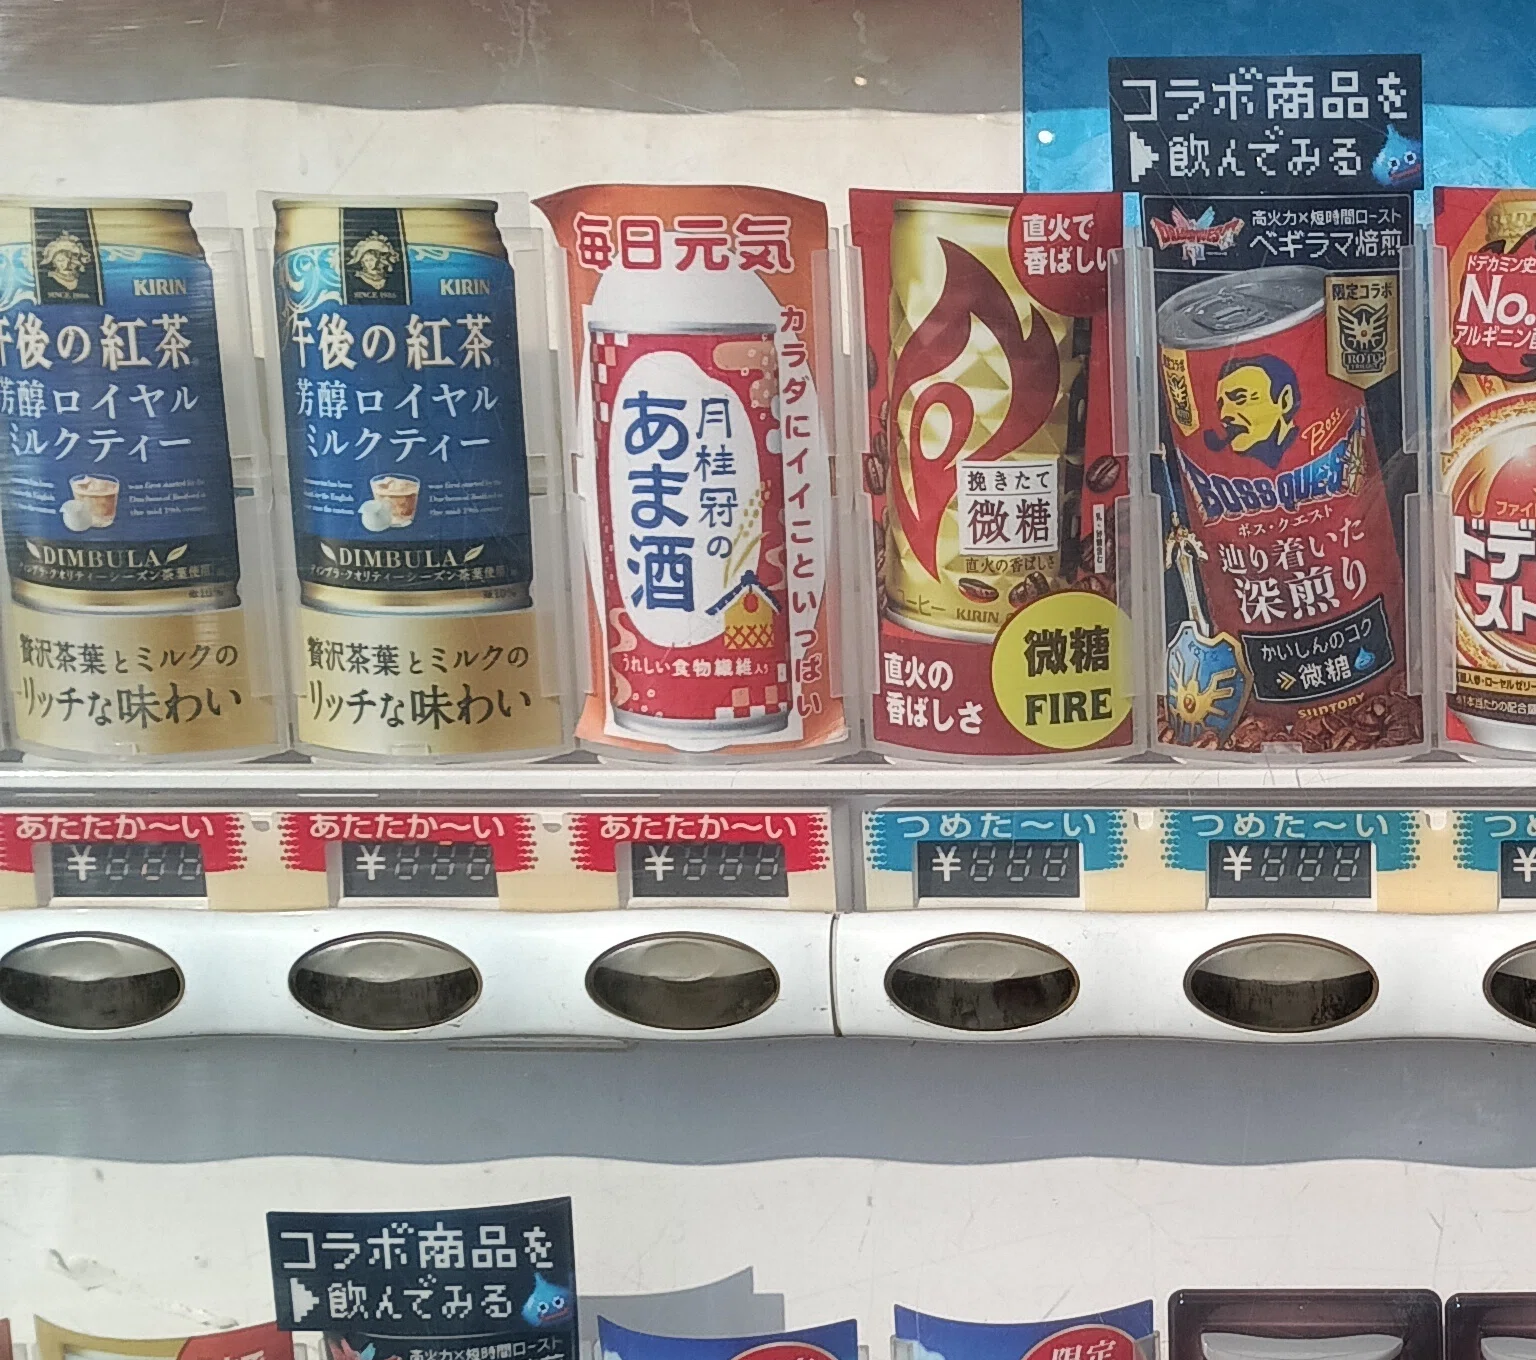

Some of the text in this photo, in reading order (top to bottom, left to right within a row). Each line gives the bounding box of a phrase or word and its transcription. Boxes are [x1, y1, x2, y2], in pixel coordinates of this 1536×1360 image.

[1122, 67, 1408, 122] コラボ商品を
[1168, 125, 1362, 177] 飲んでみる
[576, 214, 792, 273] 毎日元気
[1022, 214, 1093, 241] 直火で
[1024, 246, 1118, 275] 香ばしい
[134, 279, 186, 295] KIRIN
[440, 279, 490, 296] KIRIN
[1332, 282, 1393, 301] 限定コラボ
[292, 313, 493, 370] 午後の紅茶
[307, 423, 491, 463] ミルクティー
[694, 397, 738, 559] 月桂冠の
[968, 471, 1049, 492] 挽きたて
[623, 390, 695, 615] あま酒
[967, 499, 1052, 544] 微糖
[42, 546, 161, 568] DIMBULA
[339, 547, 457, 568] DIMBULA
[1235, 556, 1367, 624] 深煎り
[1261, 618, 1373, 662] かいしんのコク
[884, 653, 952, 689] 直火の
[21, 683, 241, 732] リッチな味わい
[309, 679, 531, 730] リッチな味わい
[886, 691, 983, 735] 香ばしさ
[1026, 690, 1112, 726] FIRE
[280, 1222, 553, 1269] コラボ商品を
[328, 1275, 512, 1320] 飲んでみる
